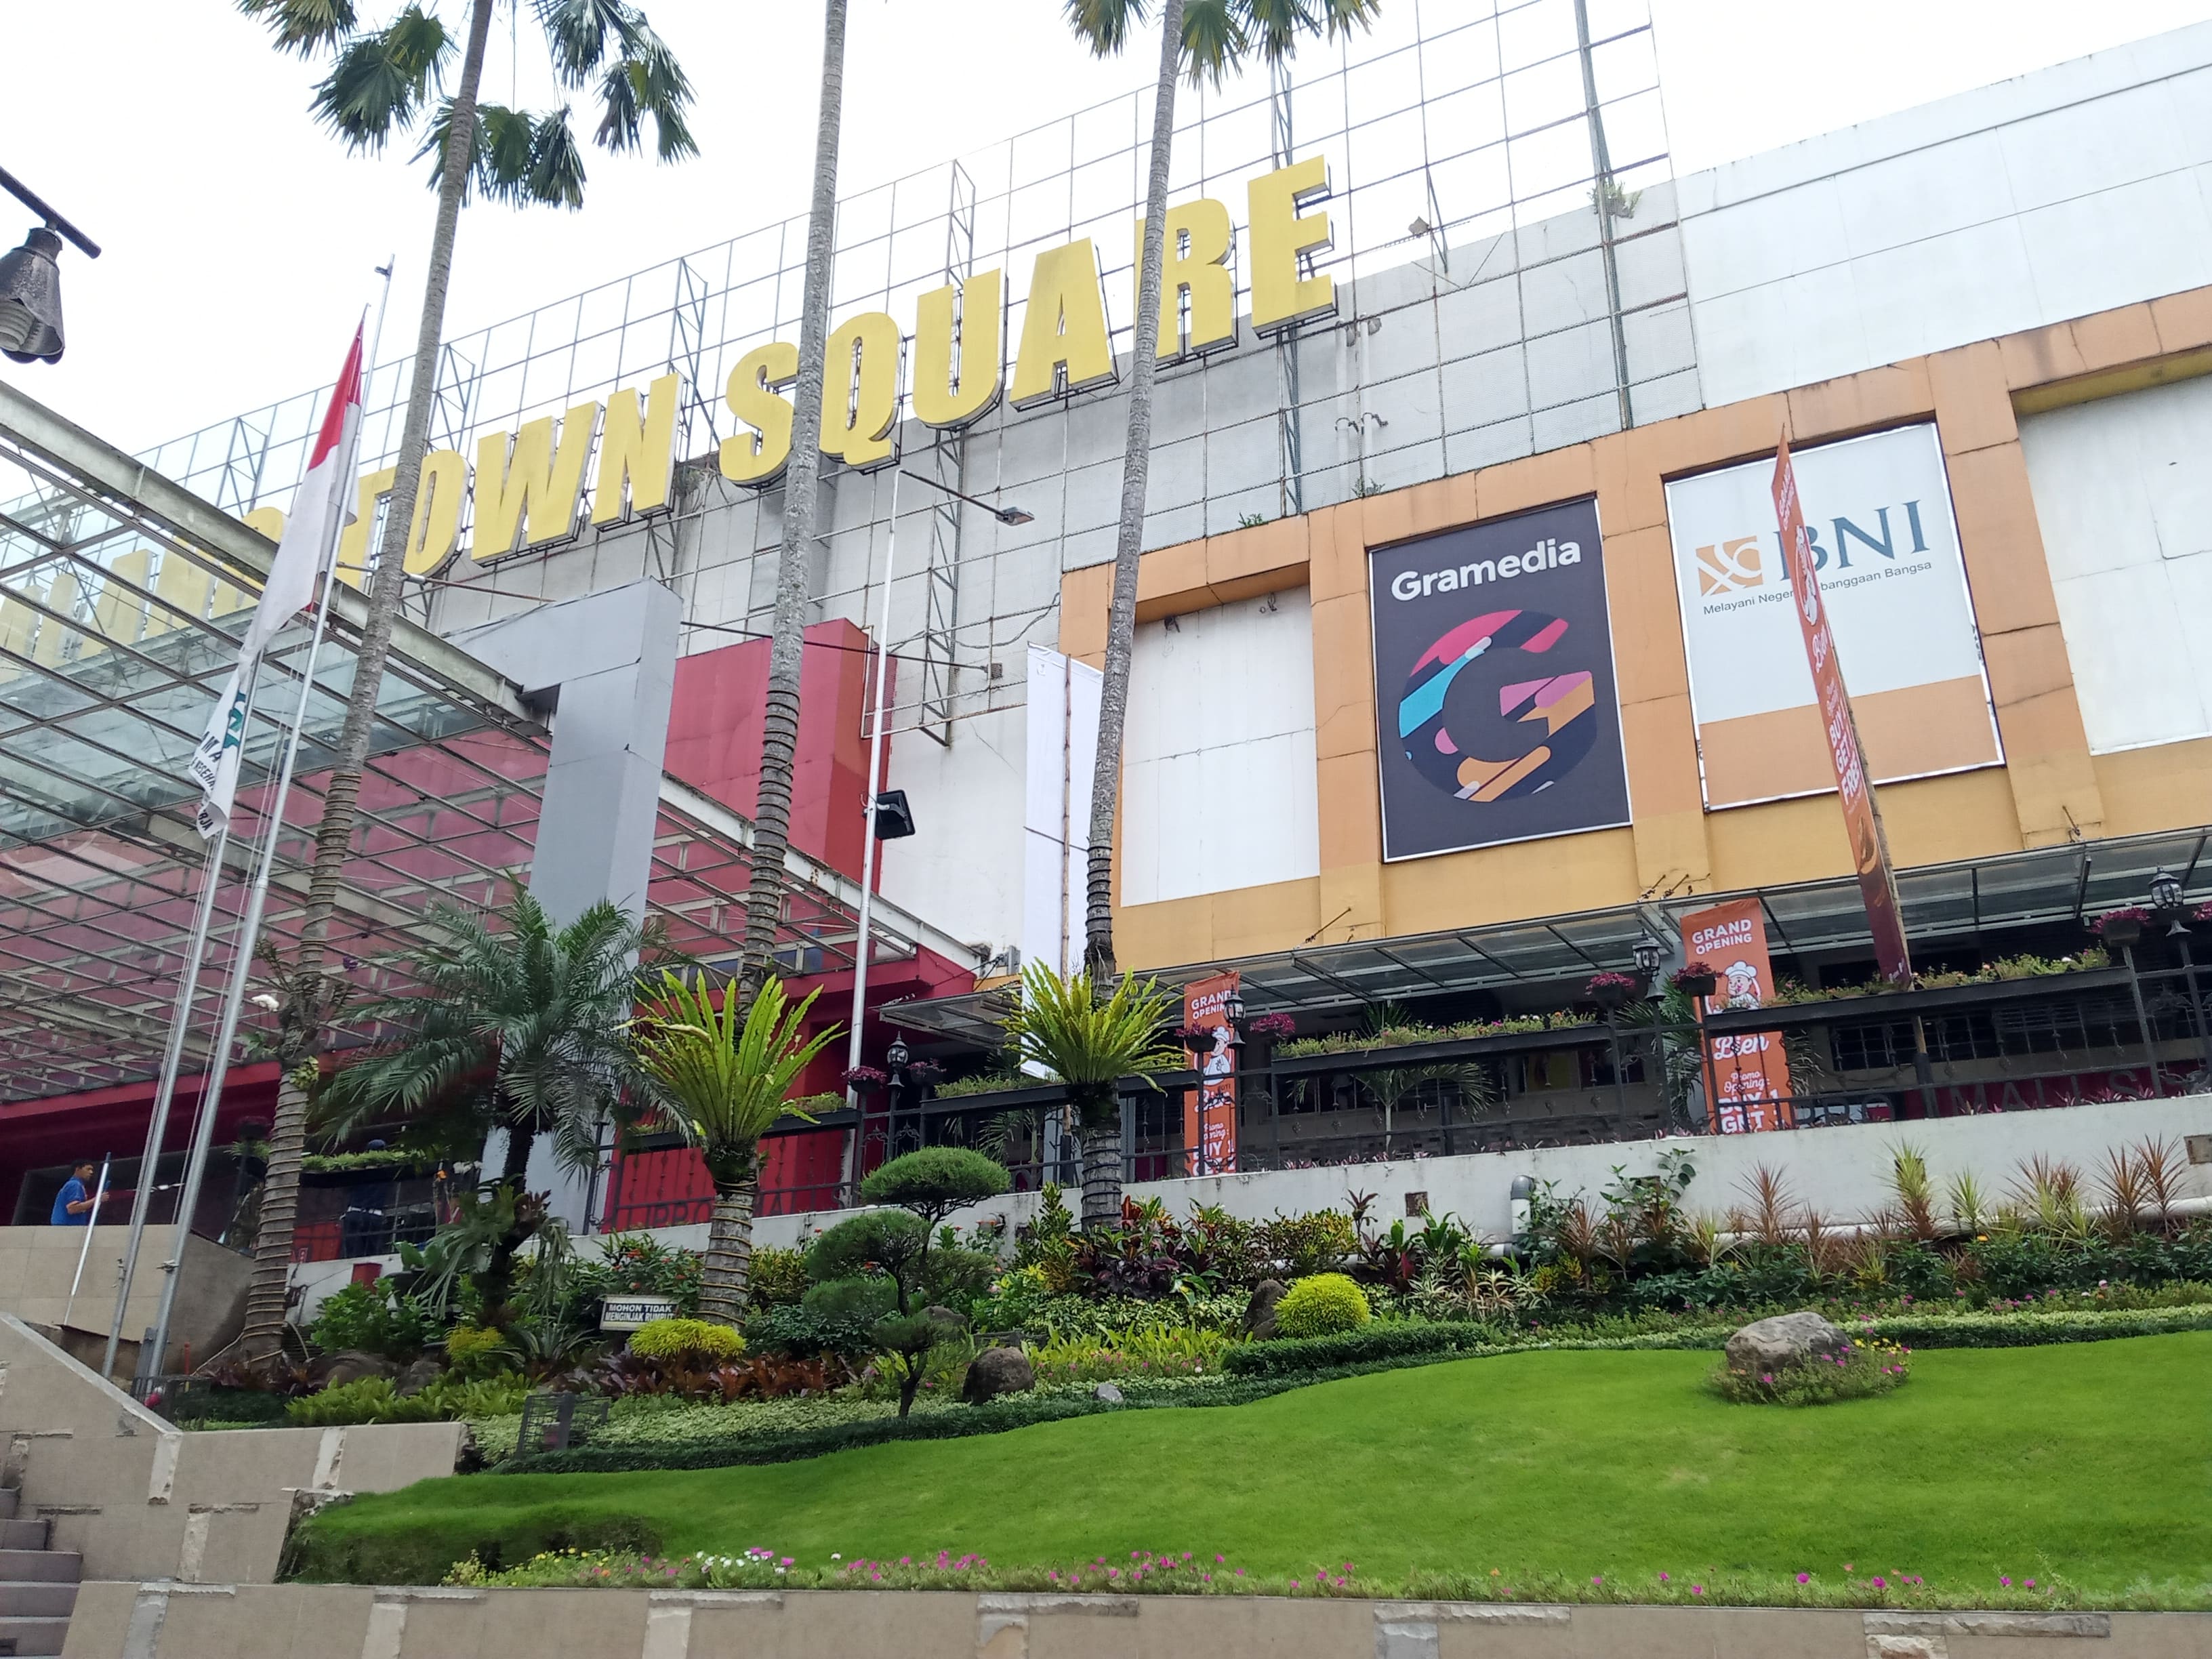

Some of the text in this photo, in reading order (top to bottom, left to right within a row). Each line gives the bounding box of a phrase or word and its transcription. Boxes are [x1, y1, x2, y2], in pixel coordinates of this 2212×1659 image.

[718, 155, 1339, 489] SQUARE
[1773, 499, 1931, 582] BNI
[1391, 537, 1582, 601] Gramedia
[1703, 560, 1933, 615] Melayani Neger banggaan Bangsa
[1691, 918, 1753, 945] GRAND
[1695, 933, 1753, 956] OPENING
[1192, 1003, 1226, 1020] OPENIN
[1713, 1034, 1769, 1061] Bien
[1718, 1092, 1762, 1115] BUY
[604, 1311, 644, 1322] MENGINJAK
[609, 1304, 673, 1313] MOHON TIDAK
